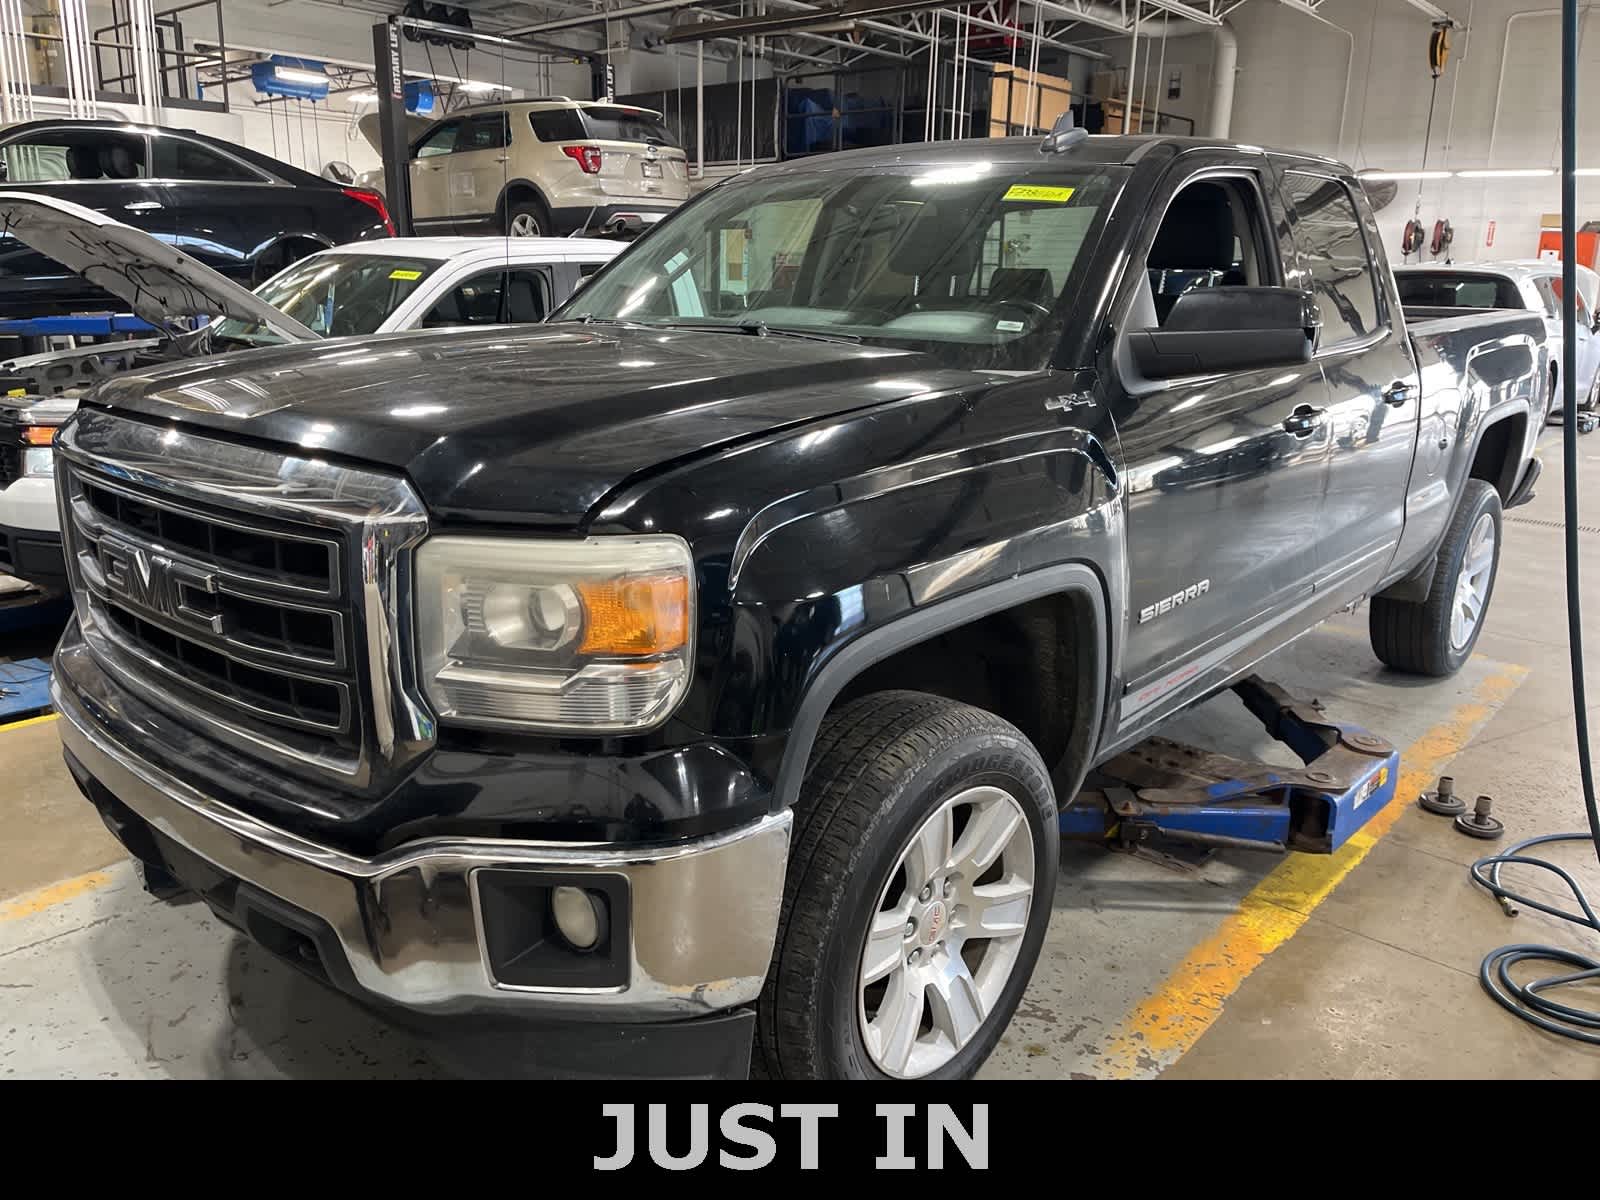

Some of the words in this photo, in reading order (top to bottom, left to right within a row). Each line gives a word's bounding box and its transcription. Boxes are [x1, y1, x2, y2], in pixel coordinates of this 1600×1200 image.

[389, 24, 399, 48] LIFT
[391, 50, 402, 94] ROTARY
[98, 533, 223, 634] GMC
[1139, 579, 1210, 624] SIERRA
